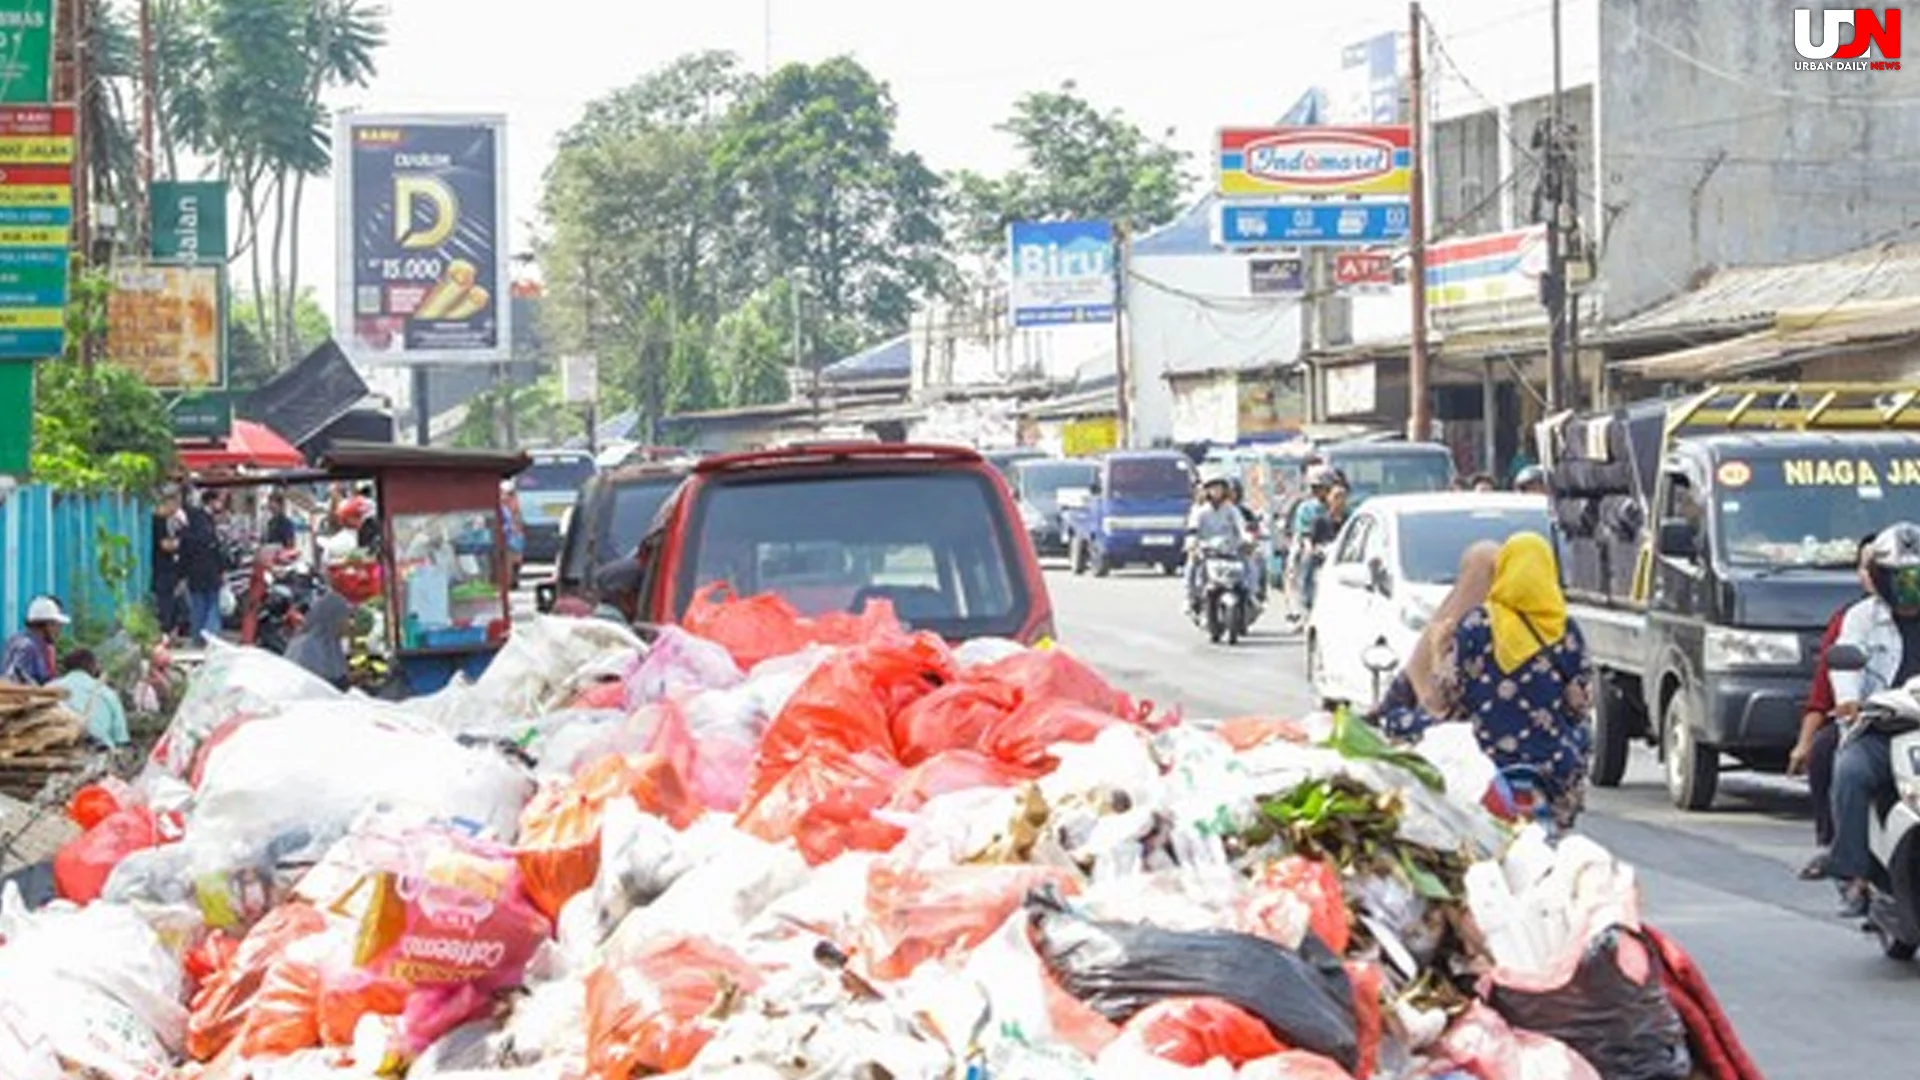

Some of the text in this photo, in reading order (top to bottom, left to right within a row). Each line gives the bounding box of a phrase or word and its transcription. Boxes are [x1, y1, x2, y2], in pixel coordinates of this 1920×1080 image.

[1255, 146, 1383, 172] Indomaret
[173, 195, 198, 266] Jalan
[383, 258, 441, 279] 15.000
[1020, 242, 1103, 278] Biru
[1783, 458, 1877, 486] NIAGA
